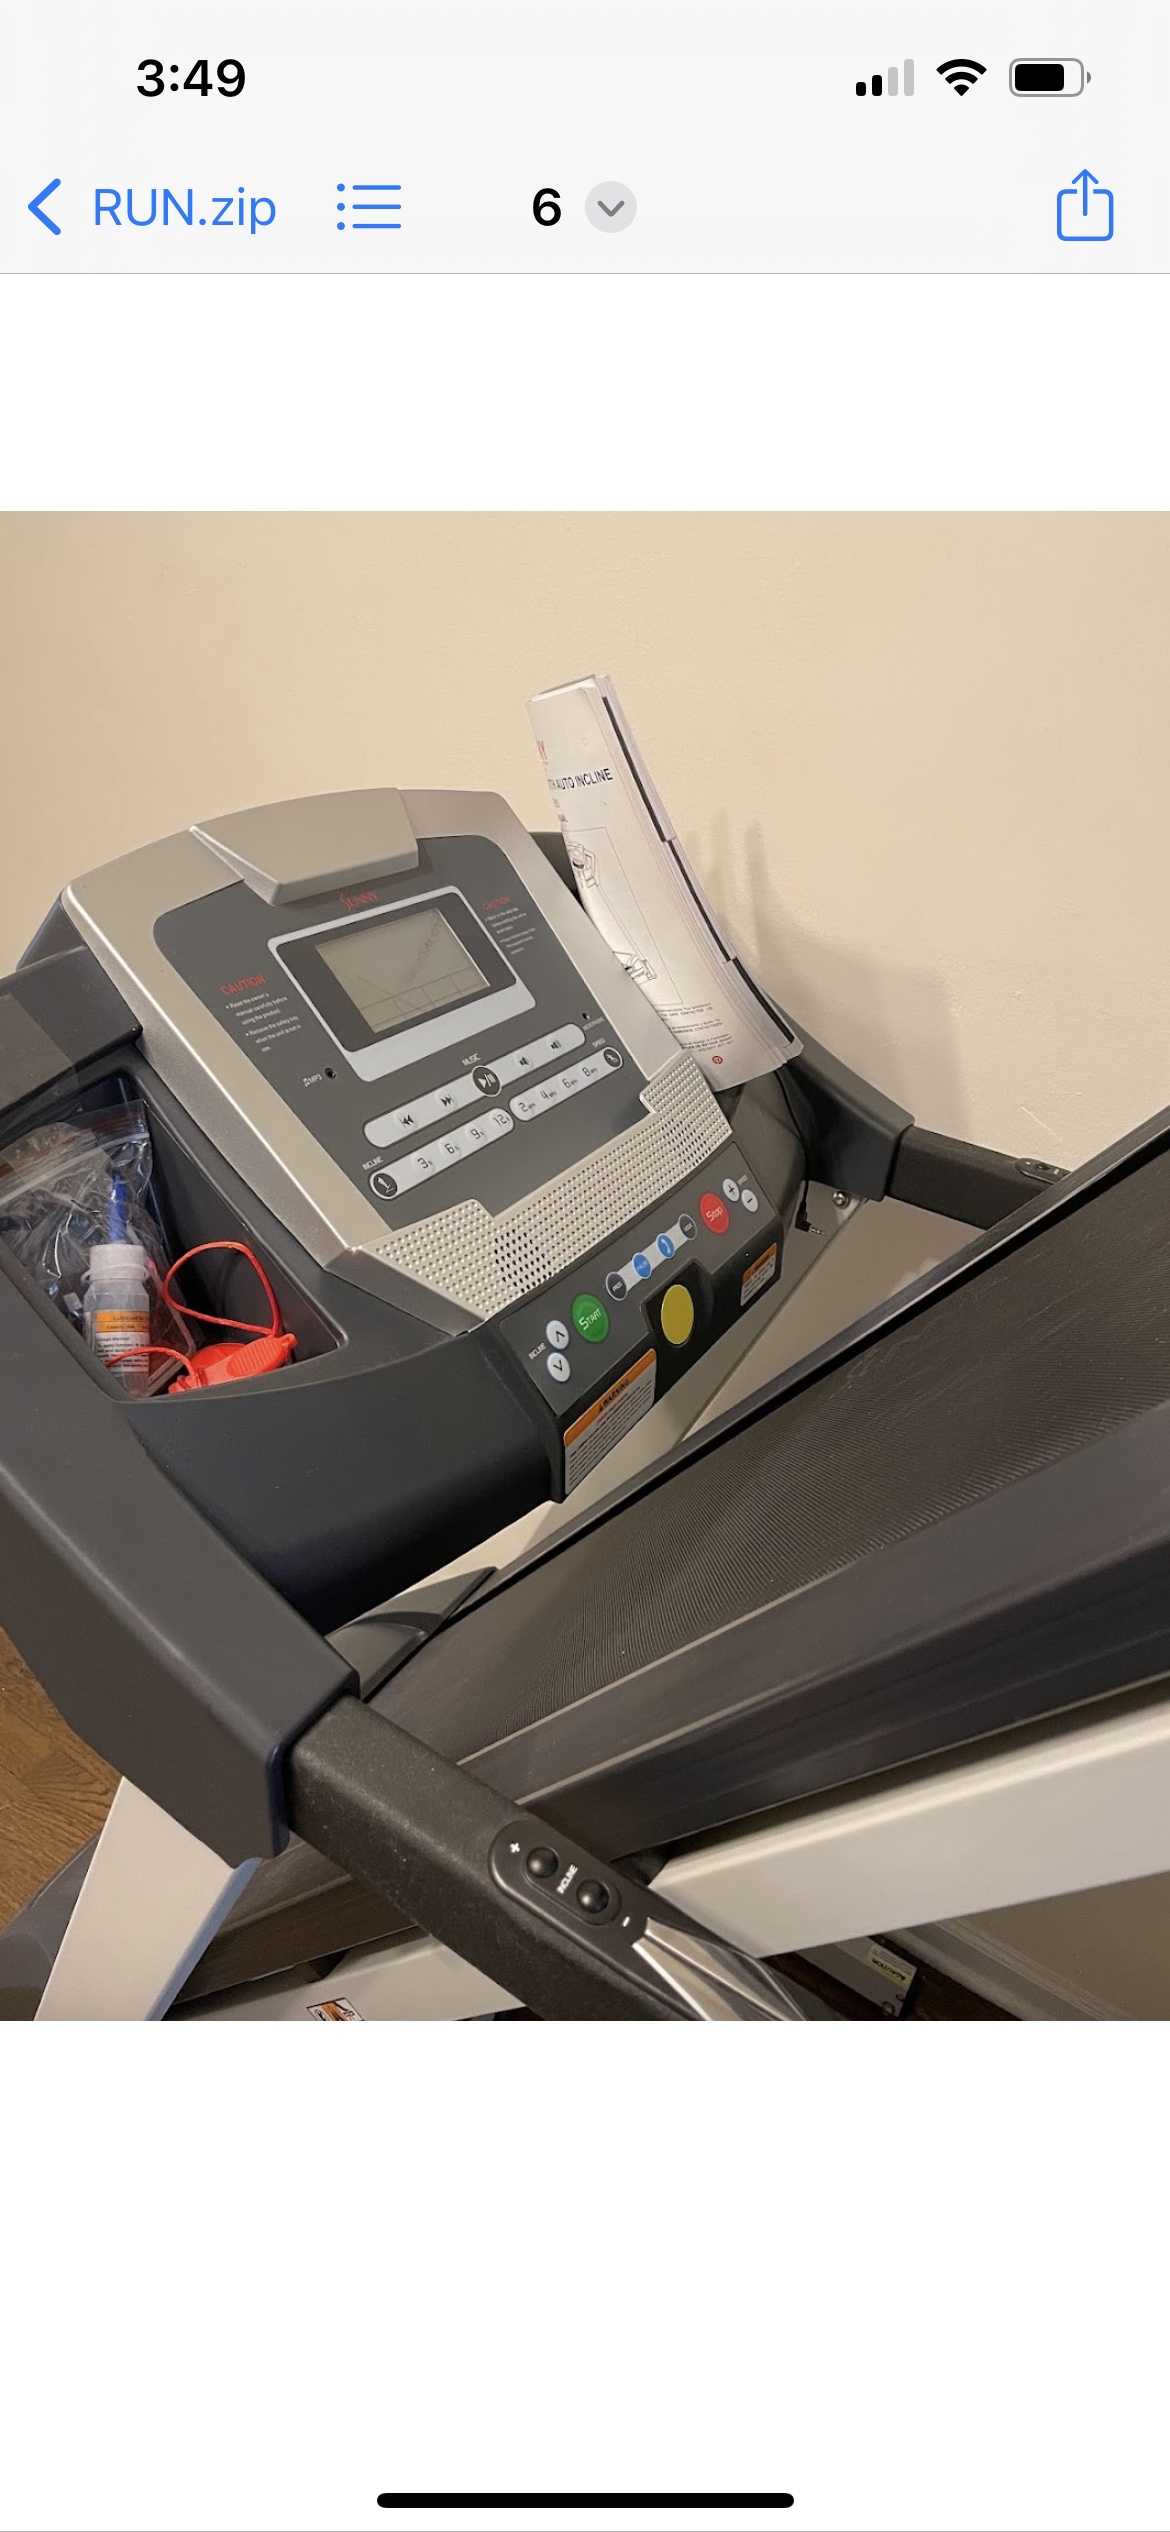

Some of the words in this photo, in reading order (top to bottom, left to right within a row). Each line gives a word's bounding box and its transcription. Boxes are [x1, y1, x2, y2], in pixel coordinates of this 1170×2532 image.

[137, 58, 246, 98] 3:49
[94, 187, 277, 235] RUN.zip
[532, 187, 562, 227] 6
[556, 777, 575, 790] AUTO
[575, 768, 613, 787] INCLINE
[220, 975, 266, 995] CAUTION
[461, 1052, 481, 1066] MUSIC
[362, 1155, 384, 1170] INCLINE
[528, 1342, 546, 1360] INCLINE
[603, 1378, 629, 1408] WARNING
[556, 1863, 578, 1894] INCLINE
